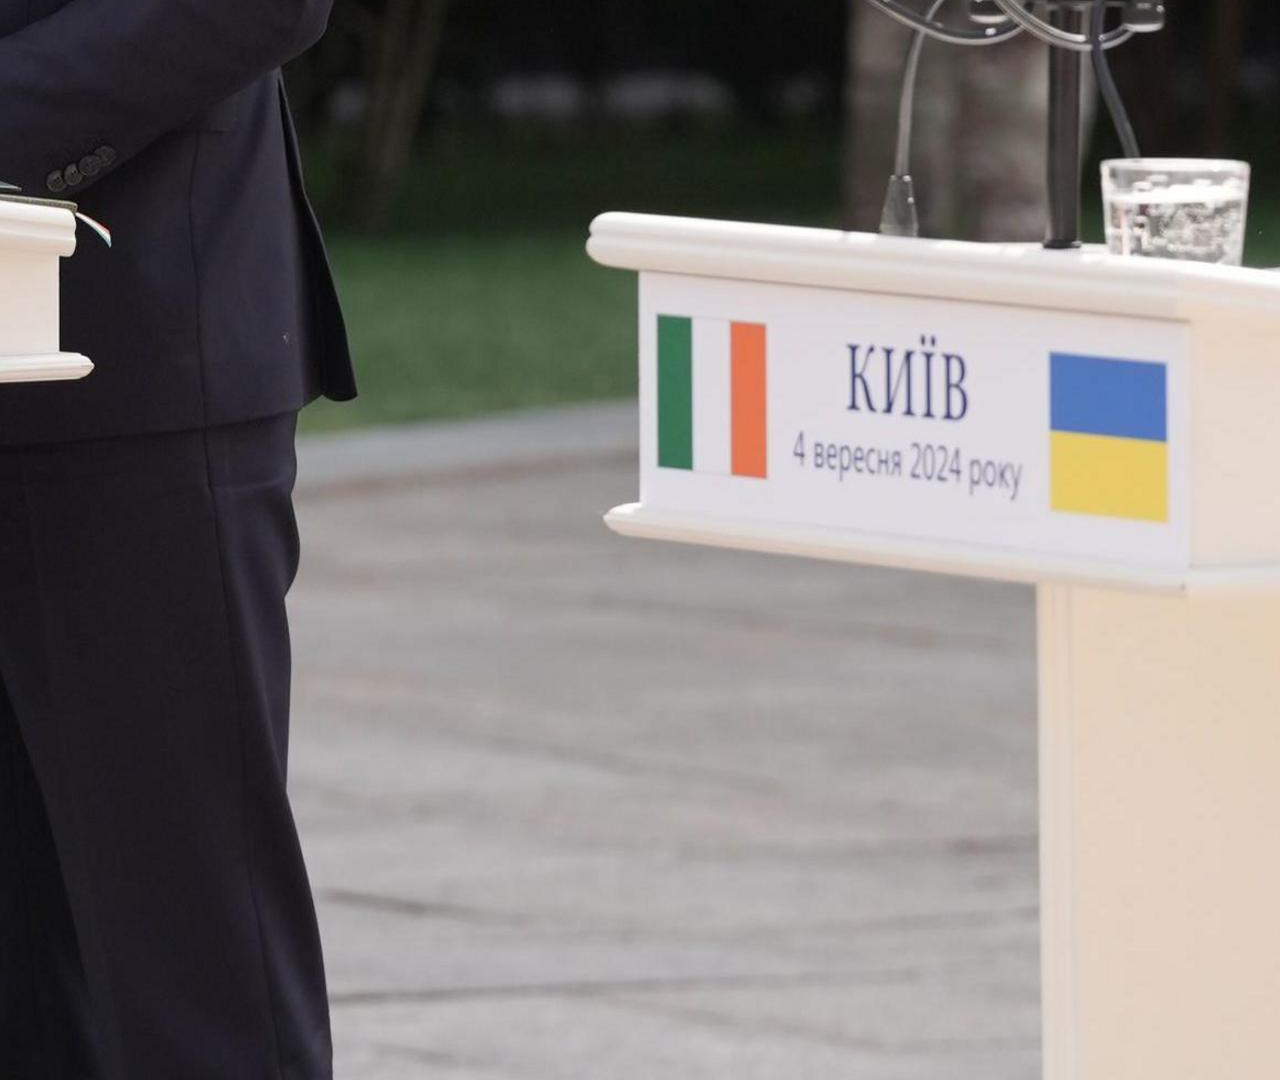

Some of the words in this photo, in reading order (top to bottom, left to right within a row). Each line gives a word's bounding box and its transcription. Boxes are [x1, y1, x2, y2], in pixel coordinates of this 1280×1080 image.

[846, 333, 969, 422] КИЇВ
[792, 430, 807, 468] 4
[813, 441, 903, 482] вересня
[909, 442, 962, 484] 2024
[968, 457, 1024, 502] року
